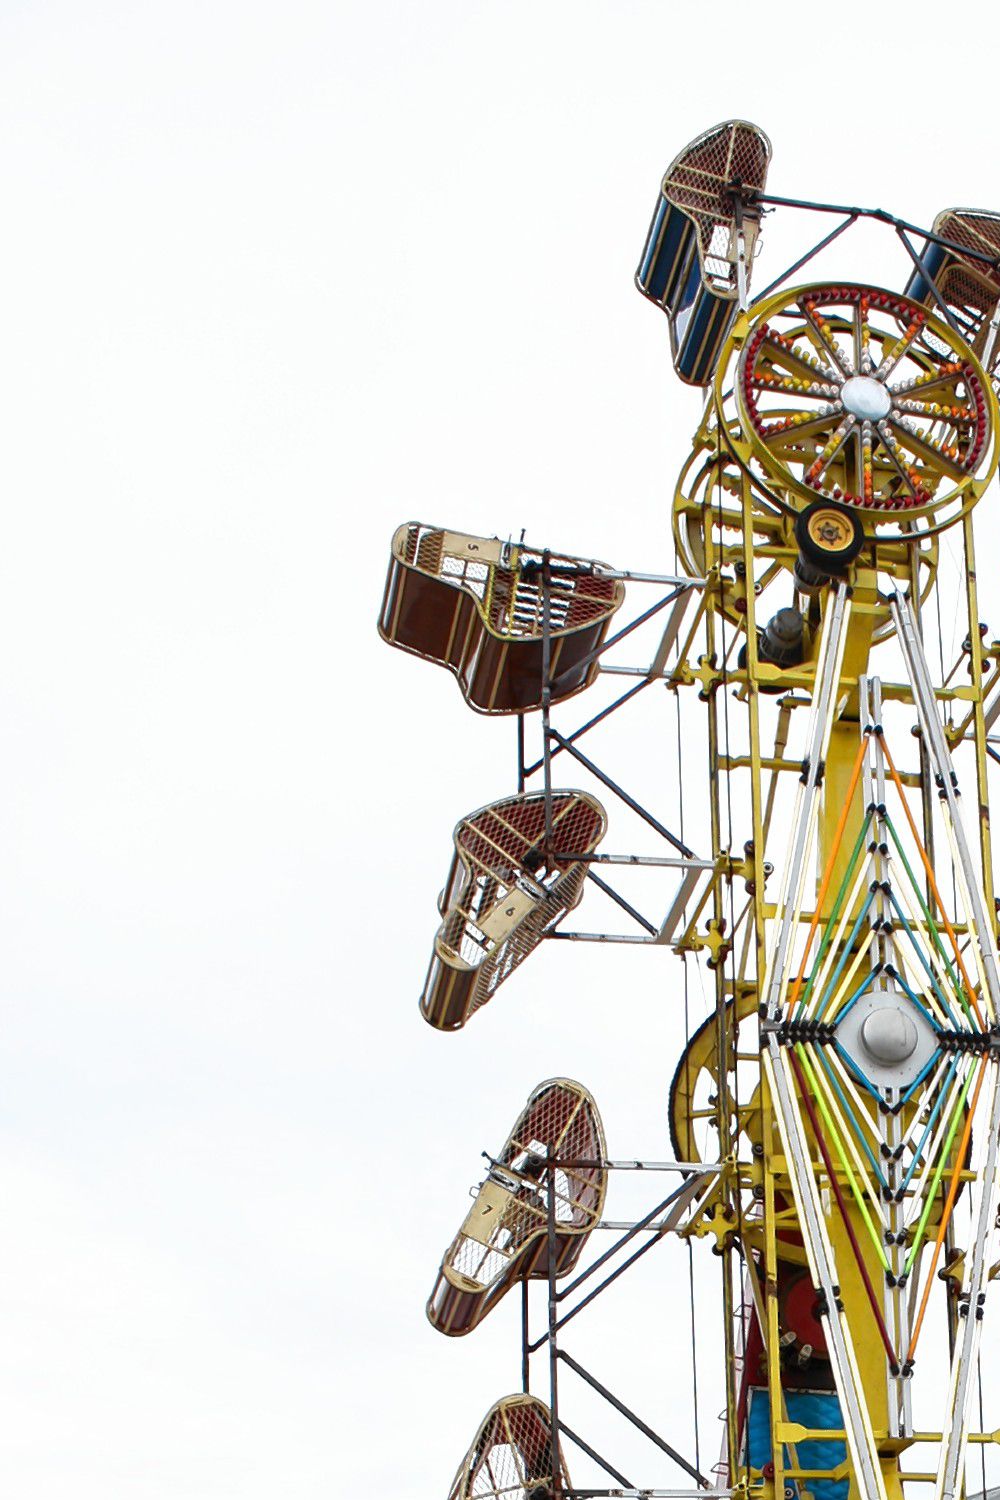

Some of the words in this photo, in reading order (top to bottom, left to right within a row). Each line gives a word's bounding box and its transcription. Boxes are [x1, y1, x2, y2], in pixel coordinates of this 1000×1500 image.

[467, 543, 479, 551] 5
[505, 906, 516, 917] 6
[481, 1204, 494, 1216] 7
